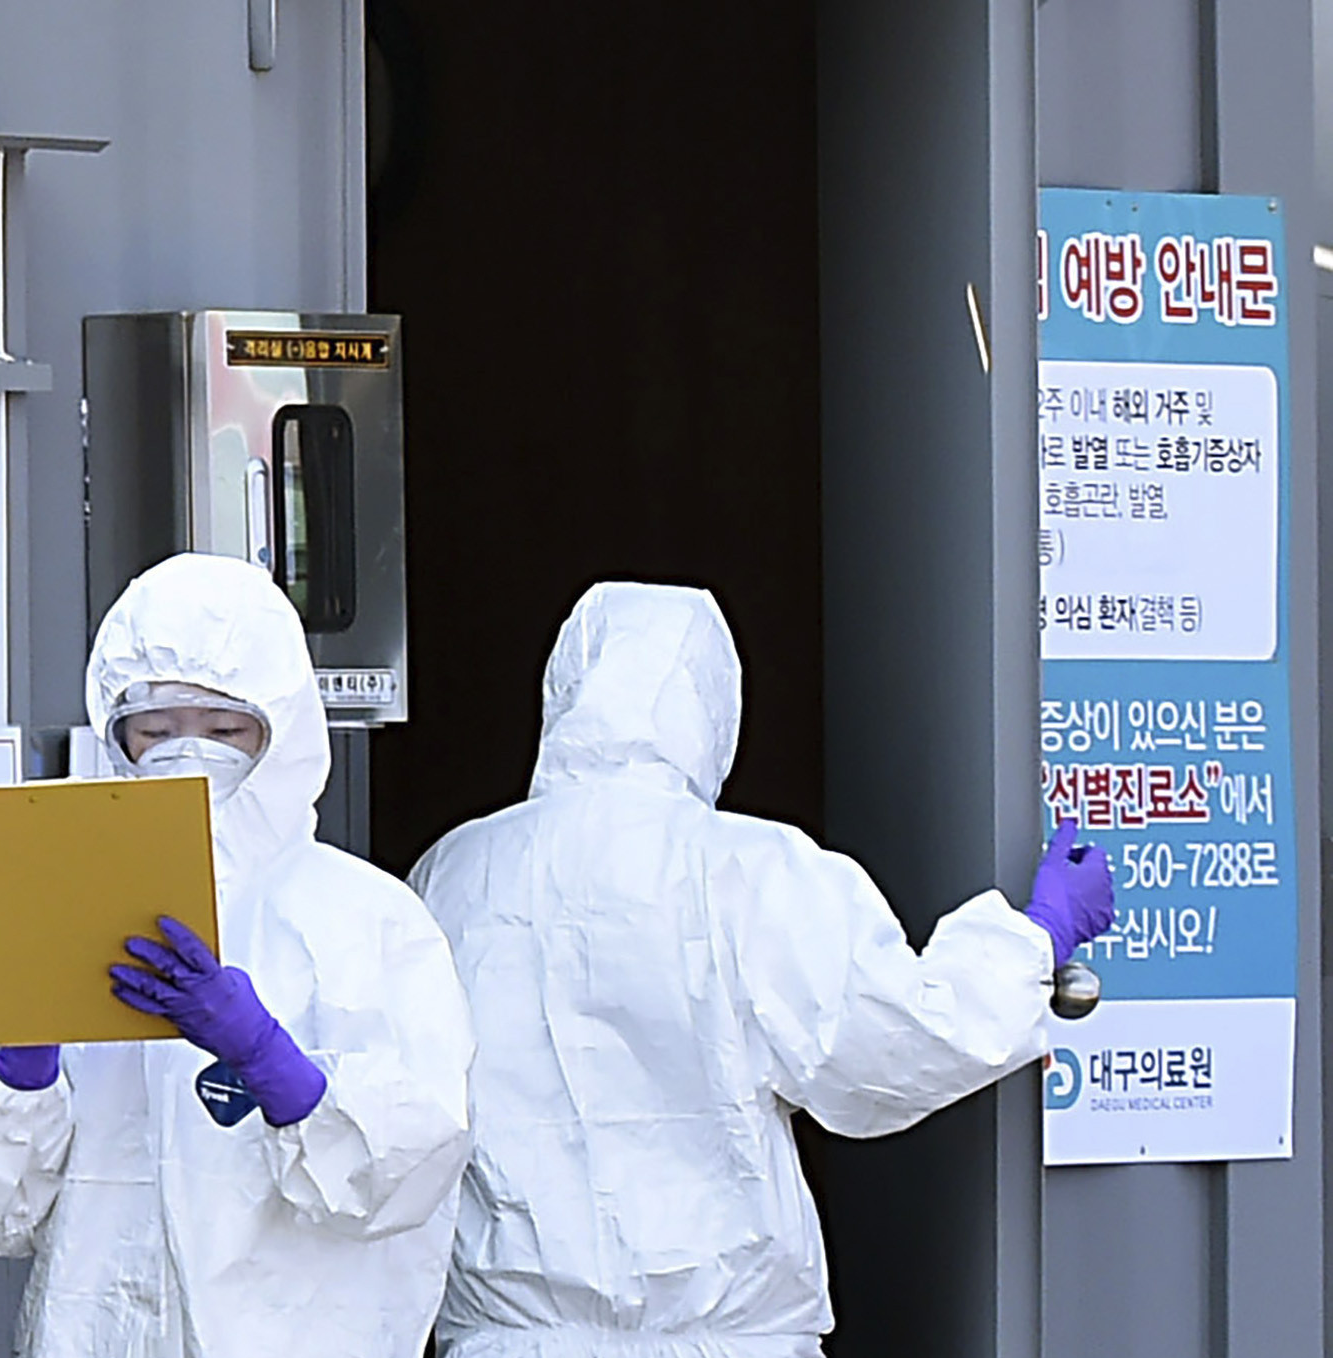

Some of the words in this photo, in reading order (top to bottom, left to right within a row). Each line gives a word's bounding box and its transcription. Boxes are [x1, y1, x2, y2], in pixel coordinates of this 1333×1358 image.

[1061, 233, 1145, 323] 예방
[1155, 236, 1277, 325] 안내문
[1070, 387, 1106, 423] 이내
[1113, 388, 1149, 425] 해외
[1155, 389, 1190, 426] 거주
[1195, 390, 1213, 426] 및
[1072, 434, 1108, 470] 발열
[1114, 436, 1151, 471] 또는
[1156, 436, 1261, 473] 호흡기증상자
[1055, 595, 1092, 631] 의심
[1180, 595, 1202, 632] 등)
[1040, 699, 1120, 752] 증상이
[1128, 700, 1207, 752] 있으신
[1212, 700, 1267, 751] 분은
[1122, 842, 1279, 888] 560-7288로
[1090, 1047, 1212, 1092] 대구의료원
